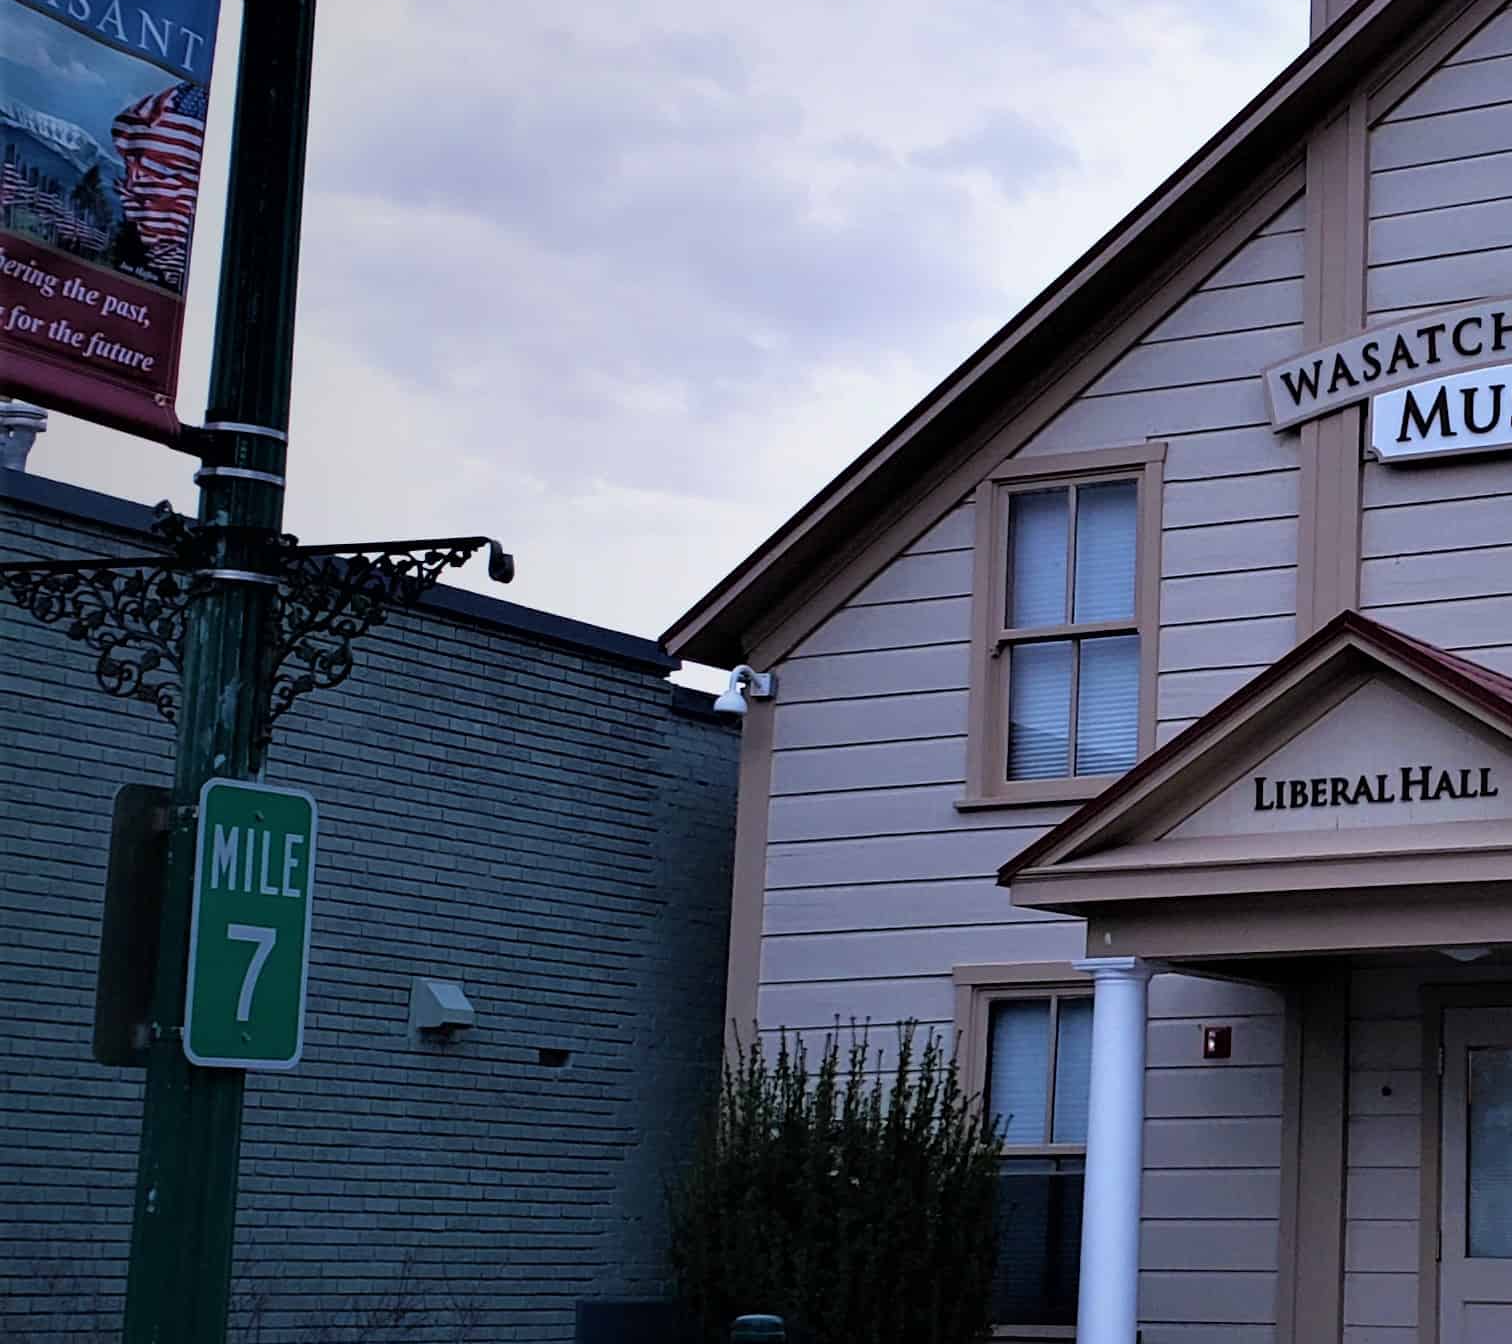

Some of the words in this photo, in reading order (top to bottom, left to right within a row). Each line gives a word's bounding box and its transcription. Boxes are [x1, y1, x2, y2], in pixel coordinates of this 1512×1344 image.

[62, 277, 99, 305] the
[101, 295, 151, 329] past,
[4, 305, 45, 333] for
[48, 319, 84, 347] the
[82, 332, 155, 372] future
[1253, 775, 1395, 812] LIBERAL
[1400, 765, 1499, 802] HALL
[210, 823, 305, 898] MILE
[227, 923, 277, 1022] 7
